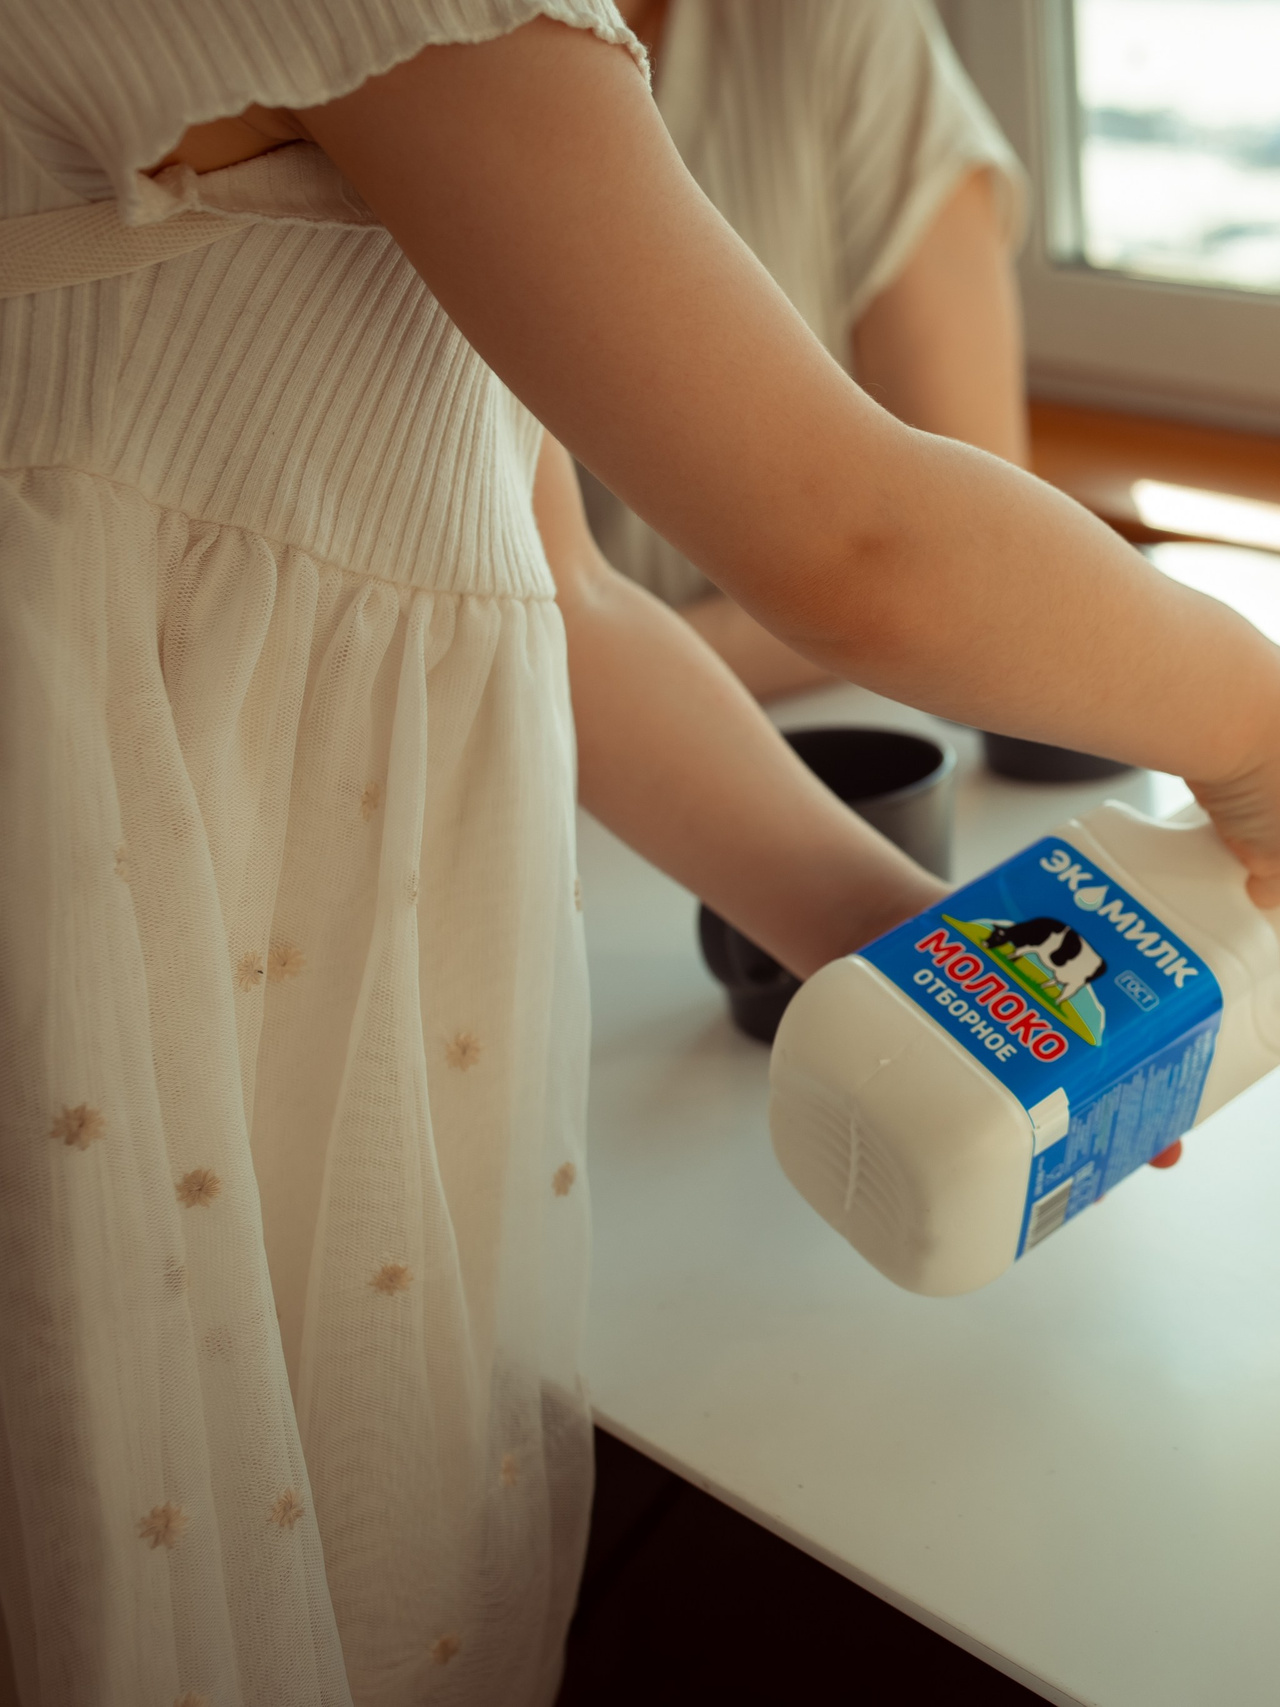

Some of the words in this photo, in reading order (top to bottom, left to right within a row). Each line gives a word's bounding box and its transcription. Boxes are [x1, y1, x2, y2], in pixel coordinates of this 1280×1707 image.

[914, 969, 1017, 1062] ОТБОРНОЕ
[915, 928, 1068, 1062] МОЛОКО
[1120, 974, 1154, 1006] ГОСТ
